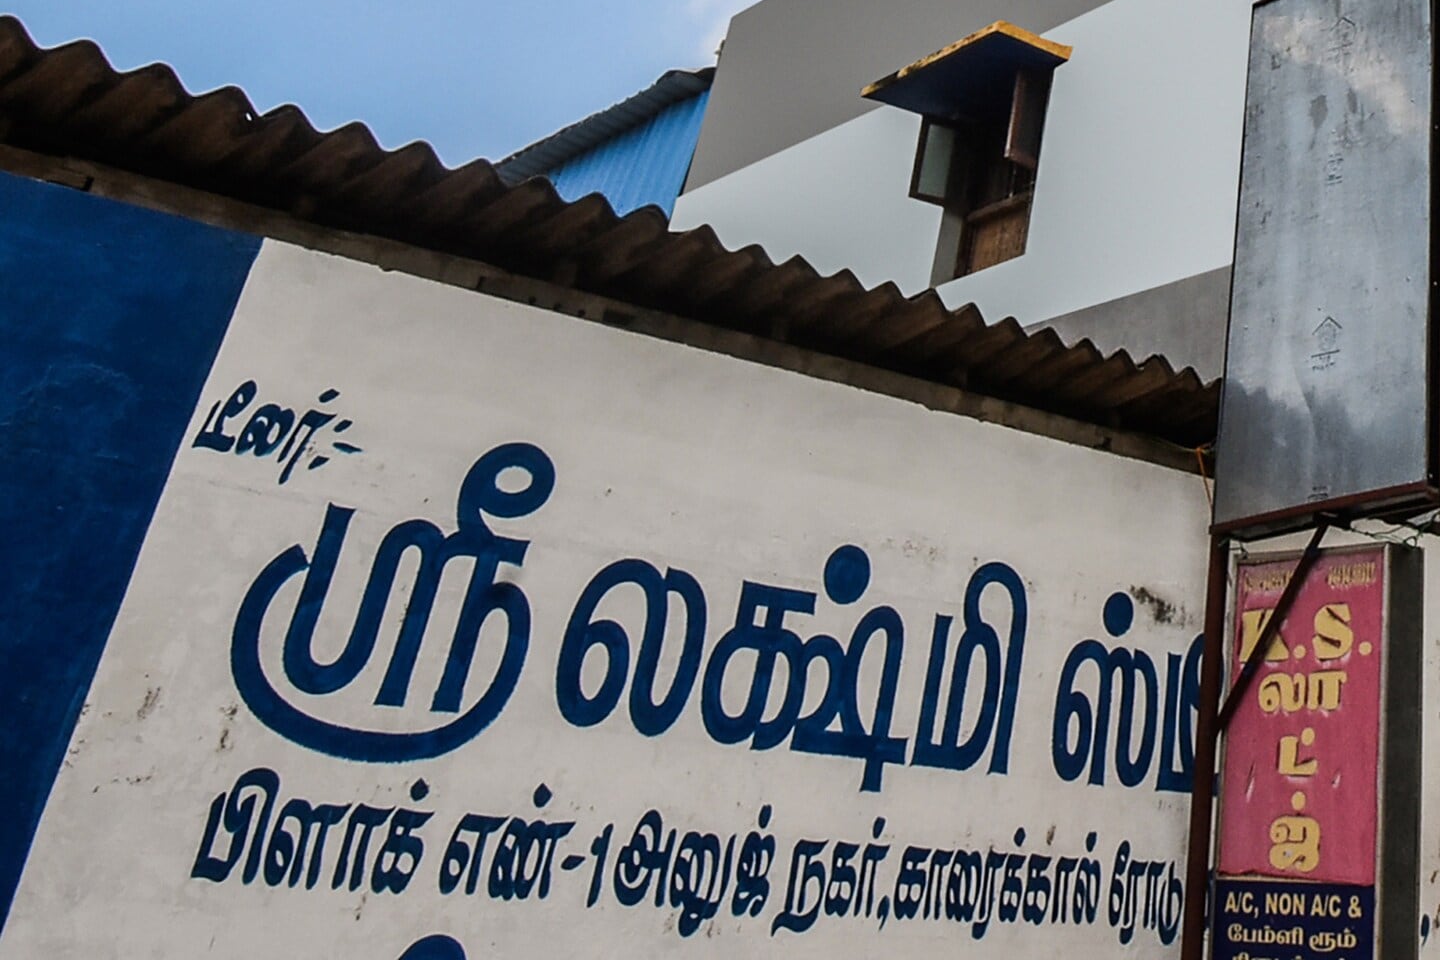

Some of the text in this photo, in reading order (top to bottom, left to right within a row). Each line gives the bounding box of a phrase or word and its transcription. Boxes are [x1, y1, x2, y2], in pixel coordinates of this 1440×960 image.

[190, 766, 435, 895] பிளாக்
[1107, 840, 1184, 946] ரோடு
[1224, 891, 1362, 919] A/C, NON A/C &
